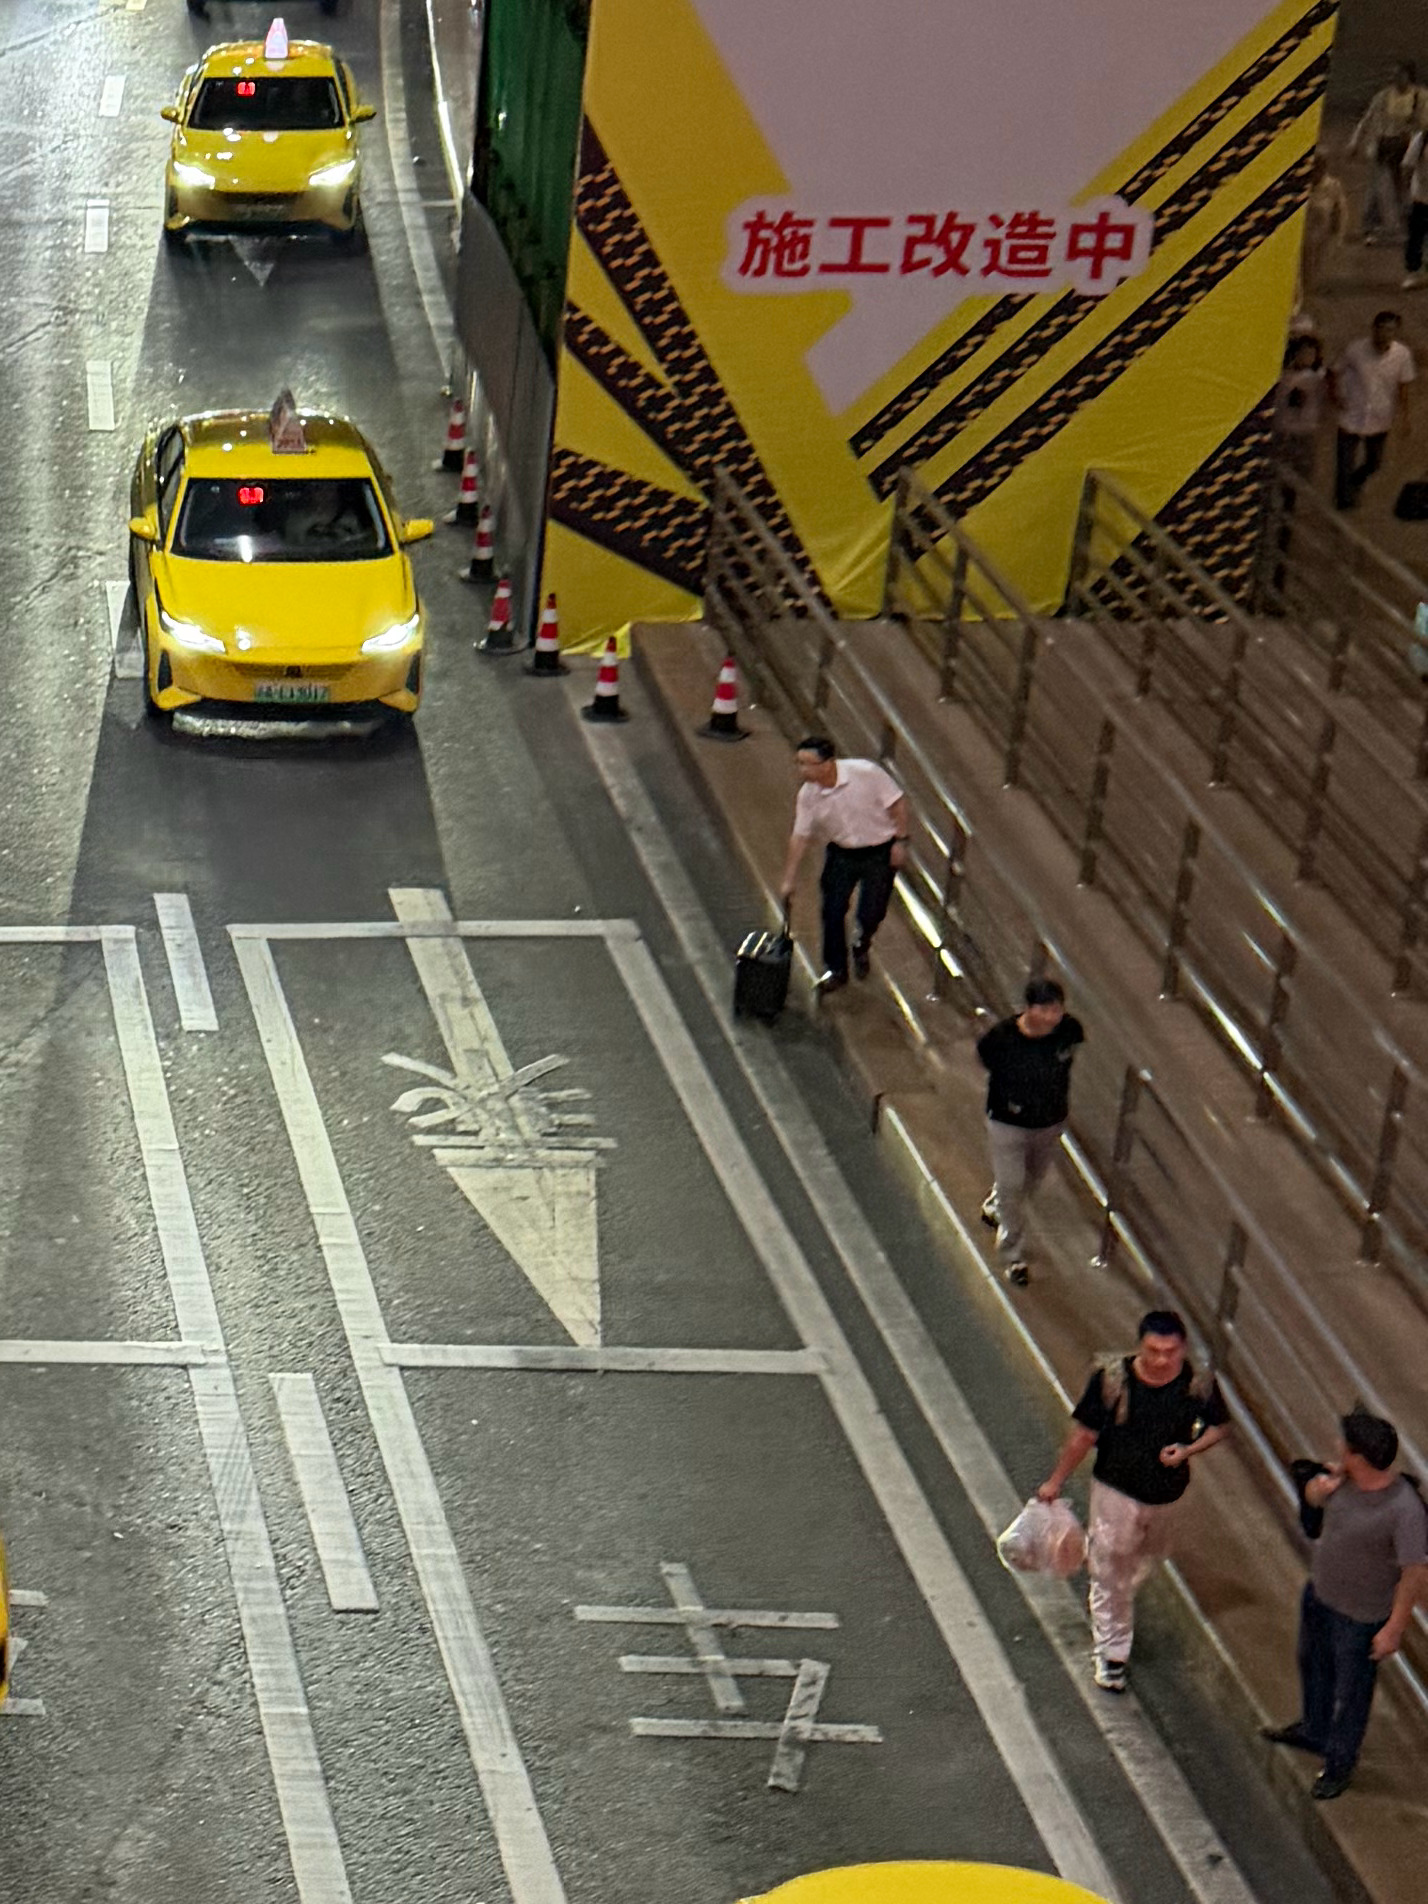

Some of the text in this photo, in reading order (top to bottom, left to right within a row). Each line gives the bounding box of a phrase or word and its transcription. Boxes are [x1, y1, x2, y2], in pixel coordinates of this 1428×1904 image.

[738, 209, 1137, 280] 施工改造中
